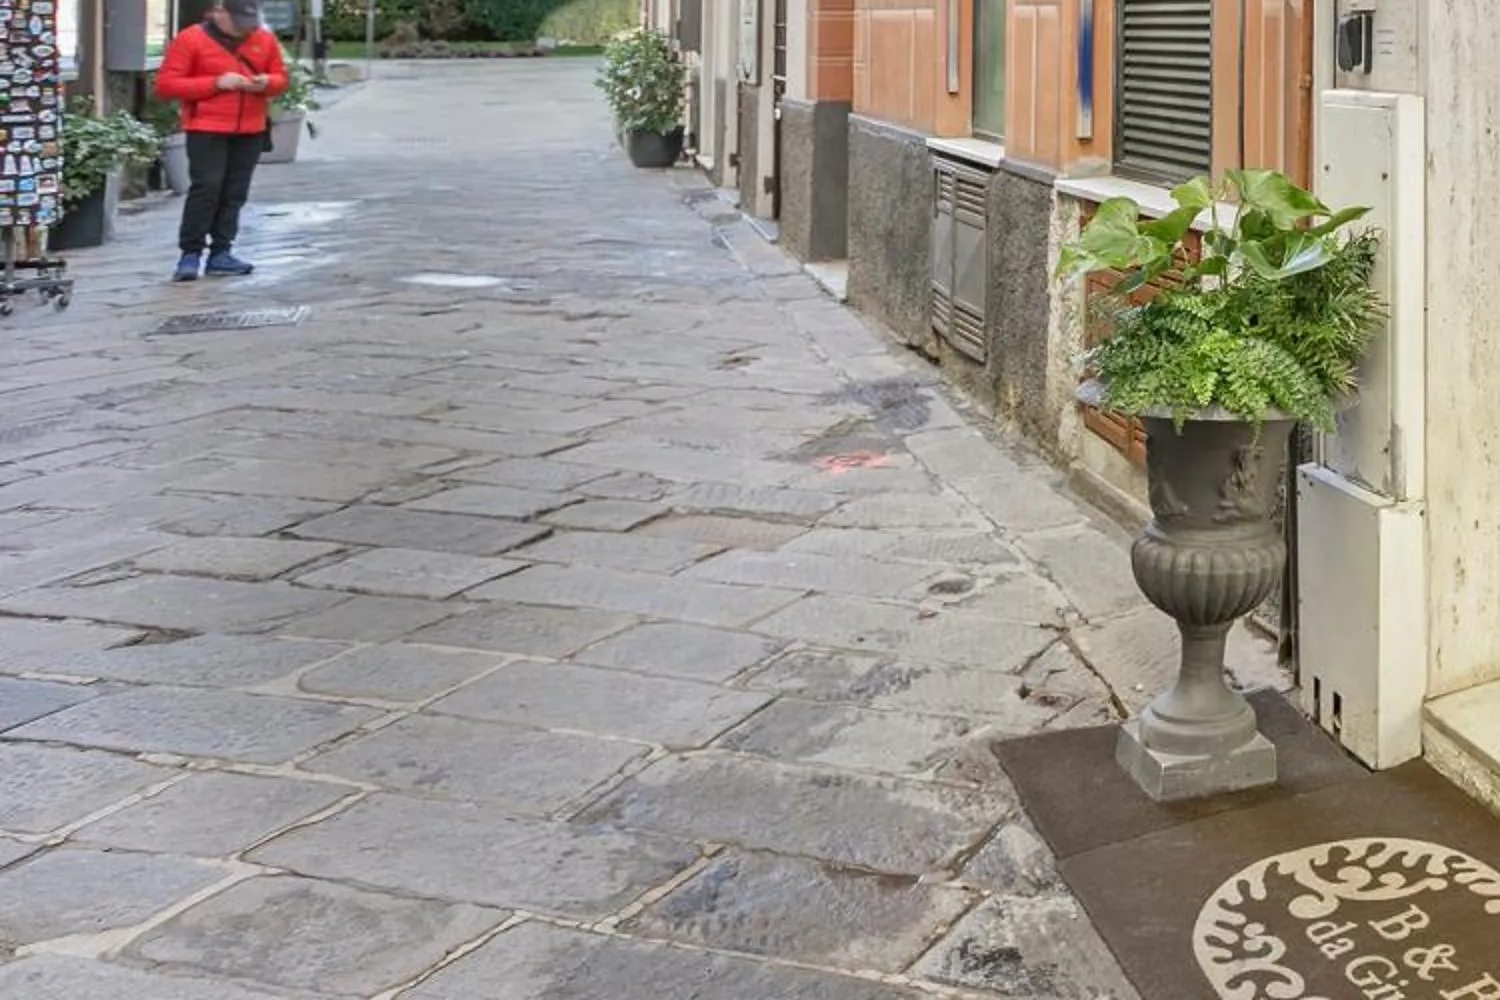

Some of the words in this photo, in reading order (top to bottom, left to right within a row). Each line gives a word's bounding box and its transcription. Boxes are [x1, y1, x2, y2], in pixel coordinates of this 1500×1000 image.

[1305, 920, 1359, 961] da
[1367, 903, 1431, 941] B
[1402, 943, 1460, 982] &
